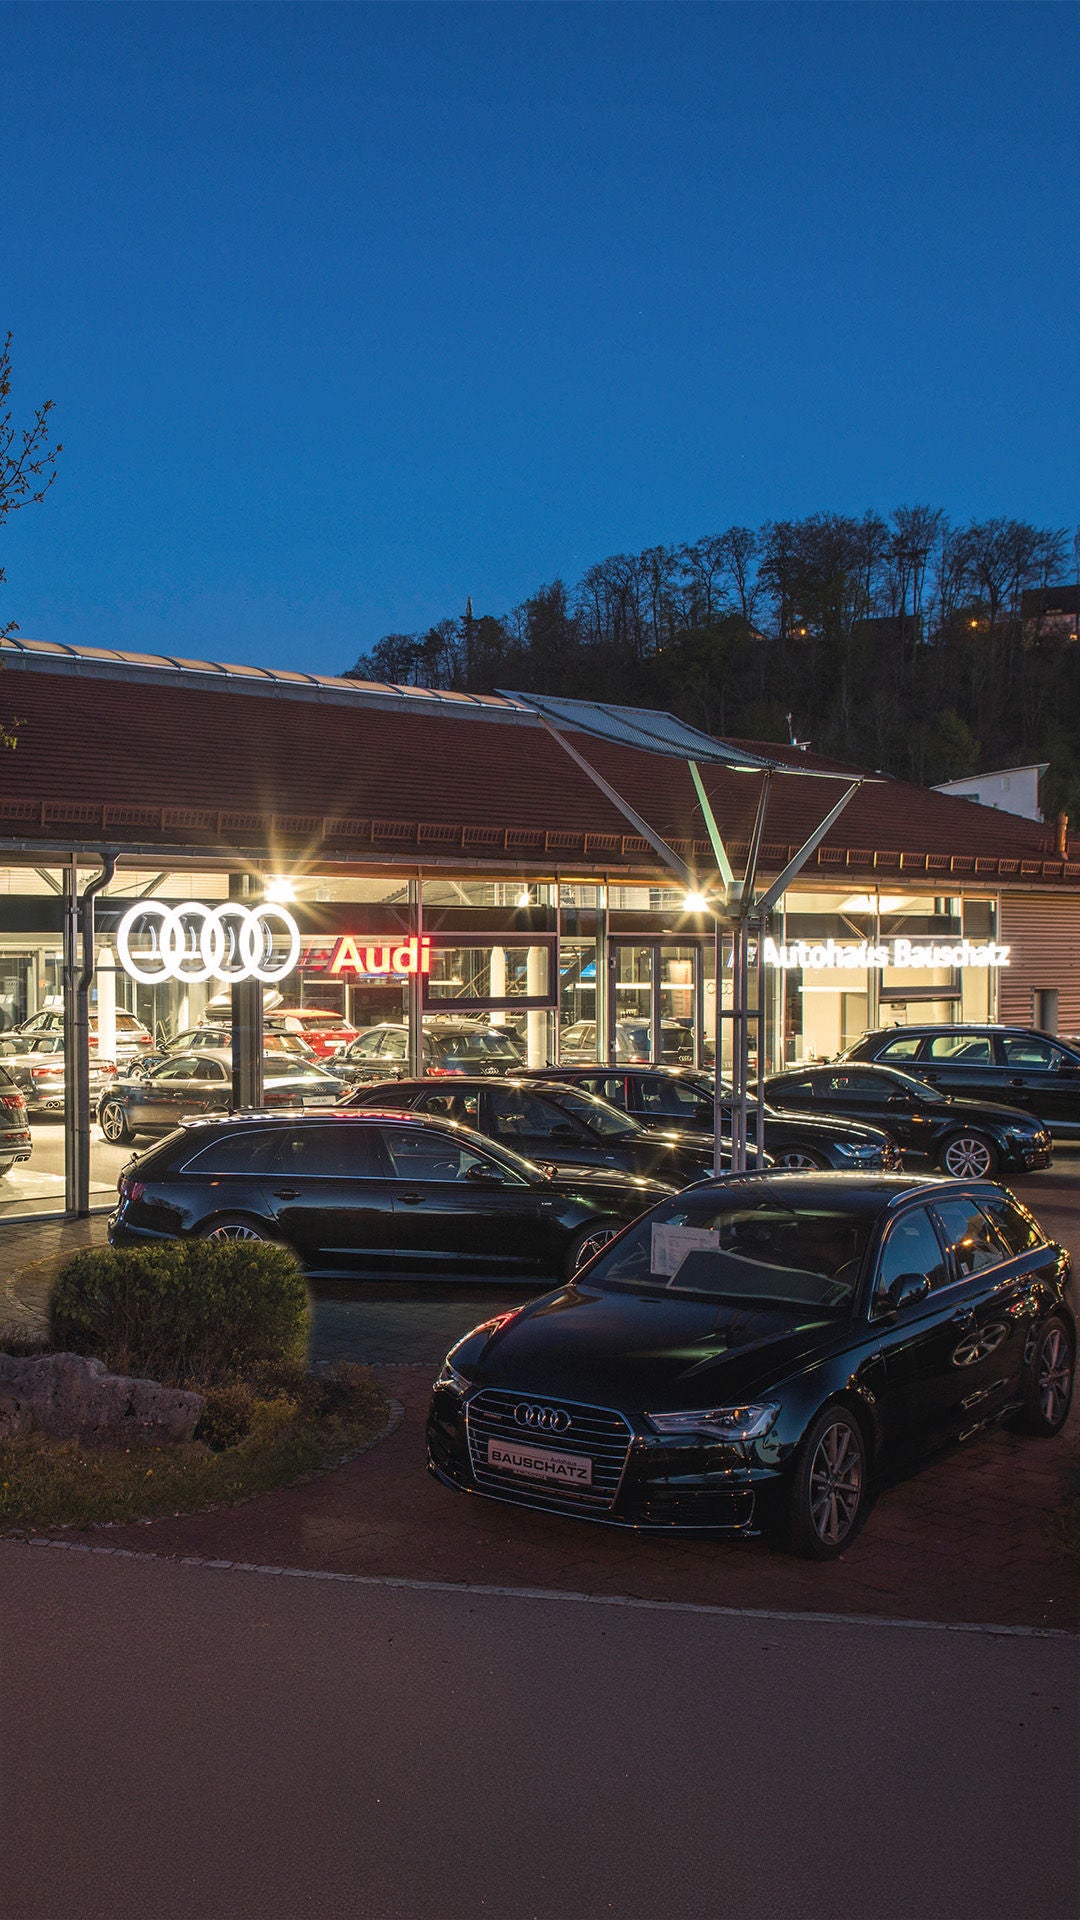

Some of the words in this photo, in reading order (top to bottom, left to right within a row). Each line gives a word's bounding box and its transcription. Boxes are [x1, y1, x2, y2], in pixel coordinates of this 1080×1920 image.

[329, 936, 431, 974] Audi
[763, 937, 889, 969] Autohaus
[894, 938, 1011, 969] Bauschatz
[491, 1450, 588, 1479] BAUSCHATZ
